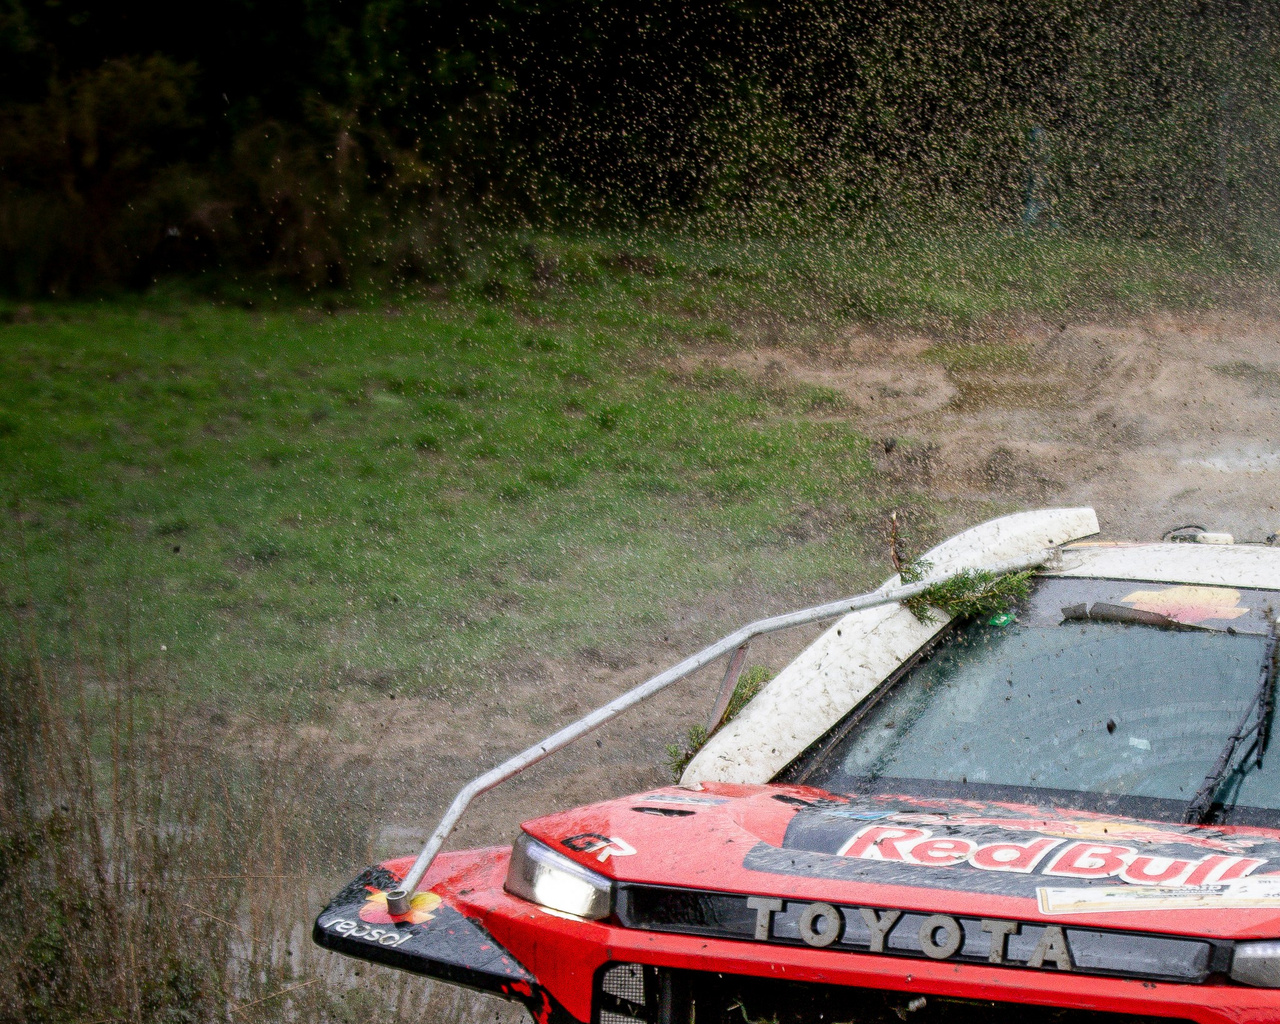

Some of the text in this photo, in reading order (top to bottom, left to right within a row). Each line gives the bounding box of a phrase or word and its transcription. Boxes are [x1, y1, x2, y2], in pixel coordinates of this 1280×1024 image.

[560, 833, 637, 863] GR
[838, 825, 1267, 886] Red Bull
[323, 918, 413, 947] repsol
[747, 896, 1072, 971] TOYOTA
